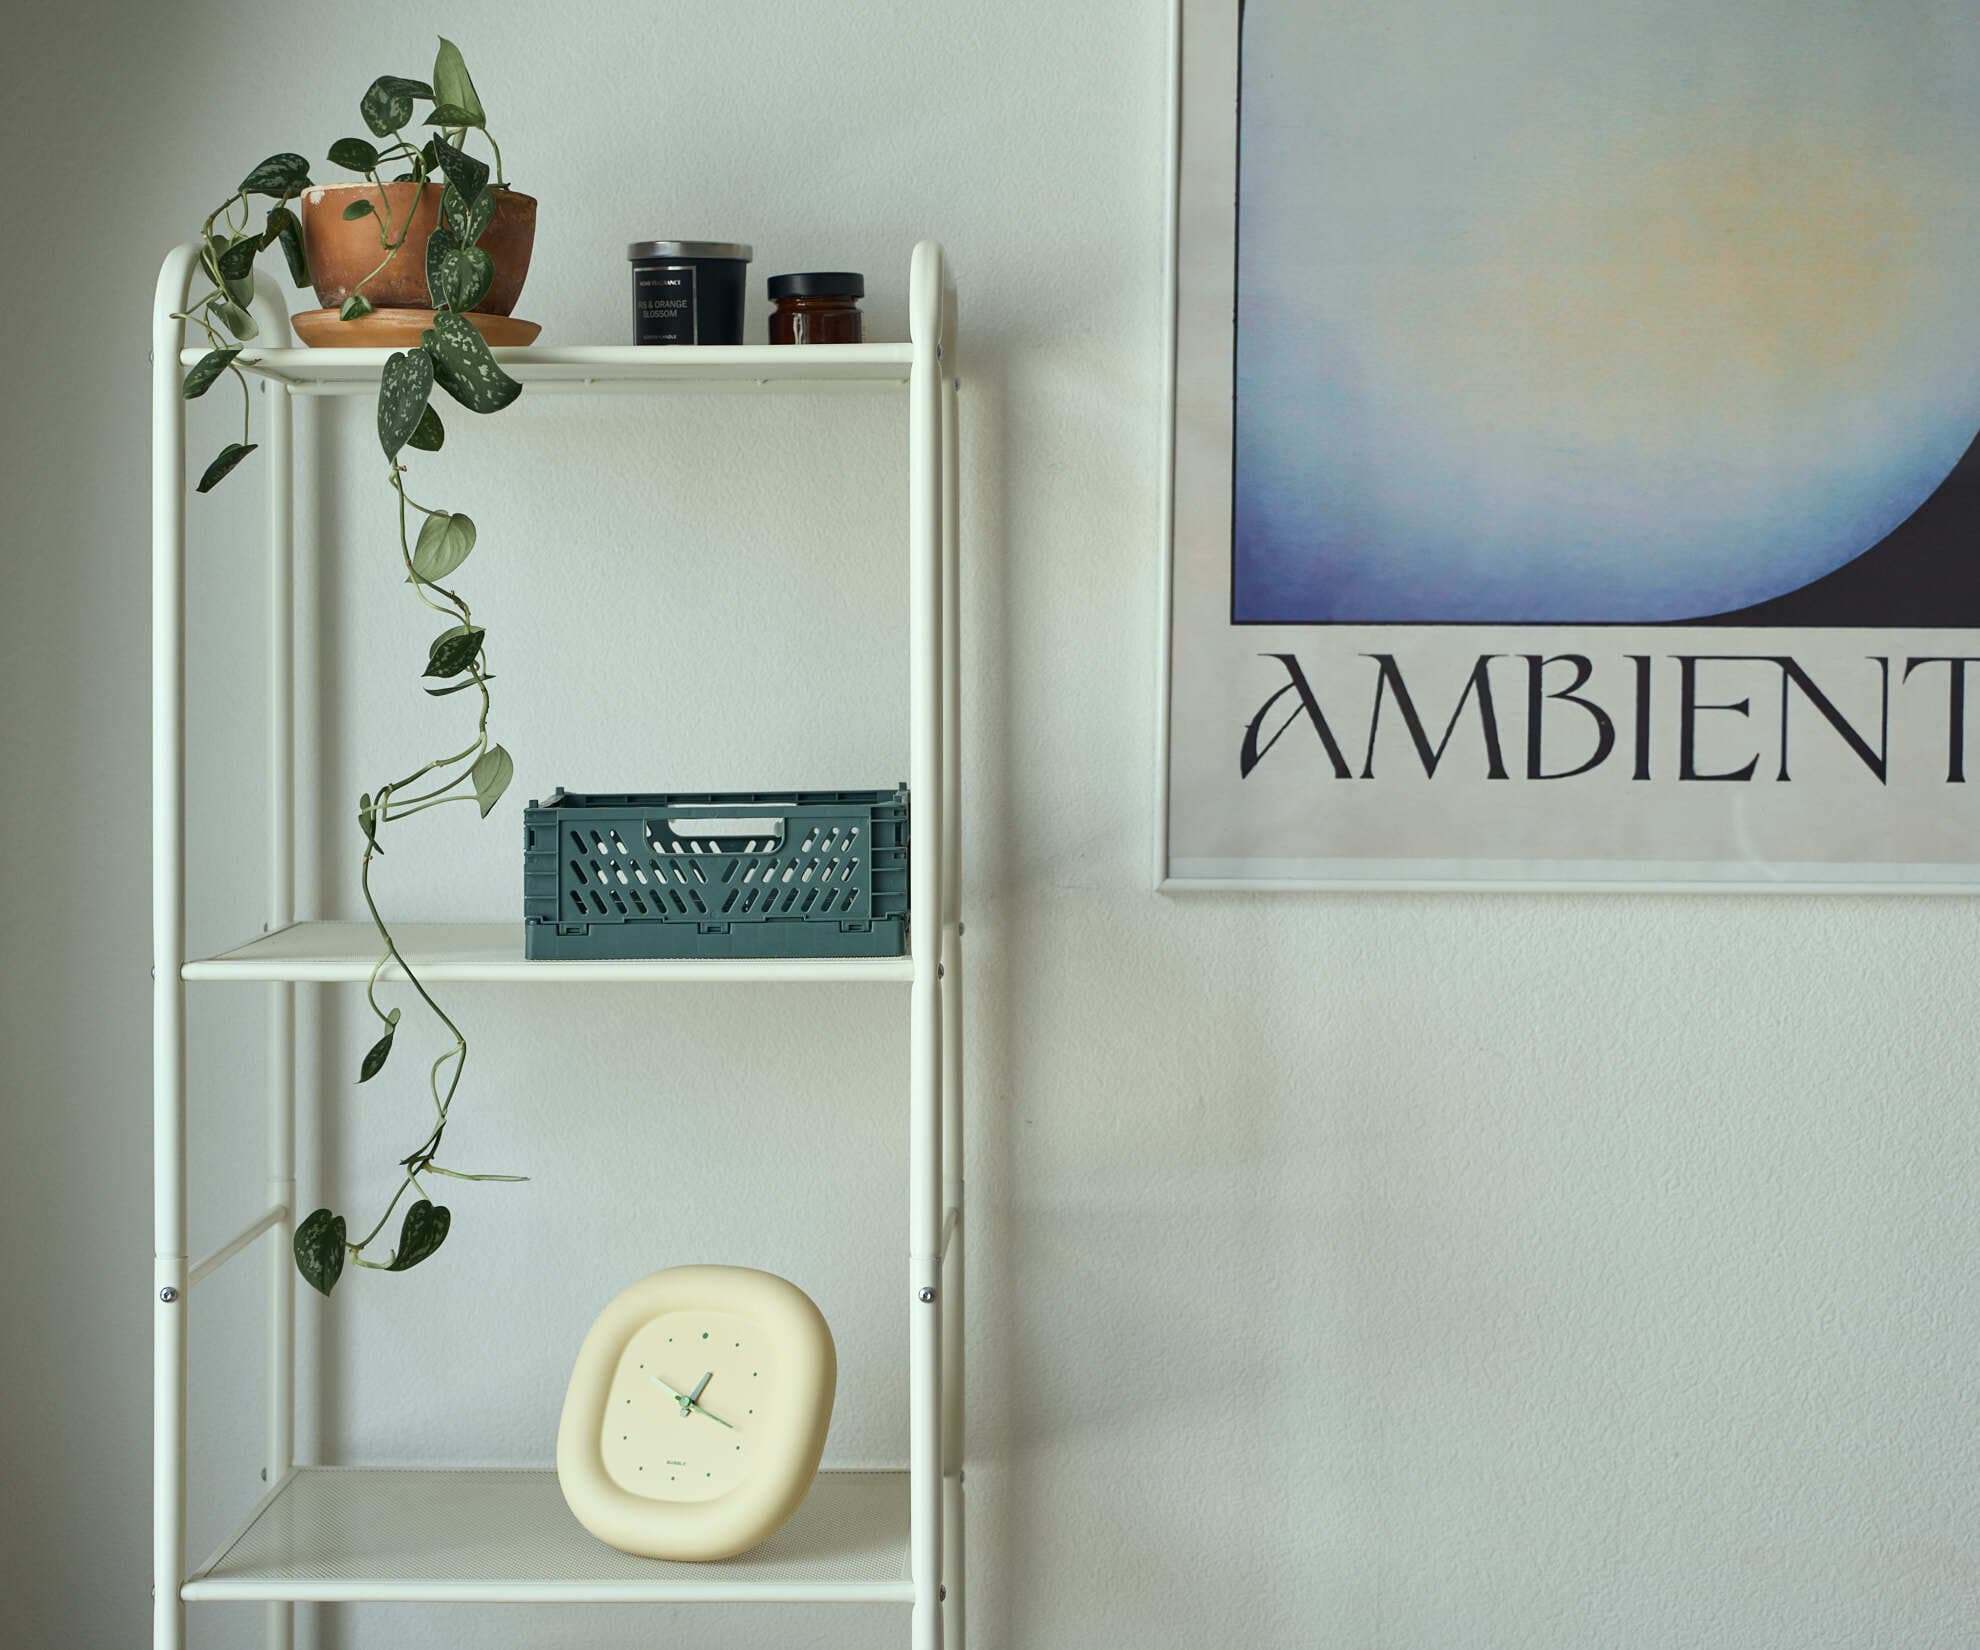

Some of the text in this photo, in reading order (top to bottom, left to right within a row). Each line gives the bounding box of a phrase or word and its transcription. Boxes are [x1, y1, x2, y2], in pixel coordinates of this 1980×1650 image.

[654, 300, 688, 309] ORANGE
[643, 309, 678, 319] BLOSSOM
[1240, 653, 1980, 787] AMBIENT
